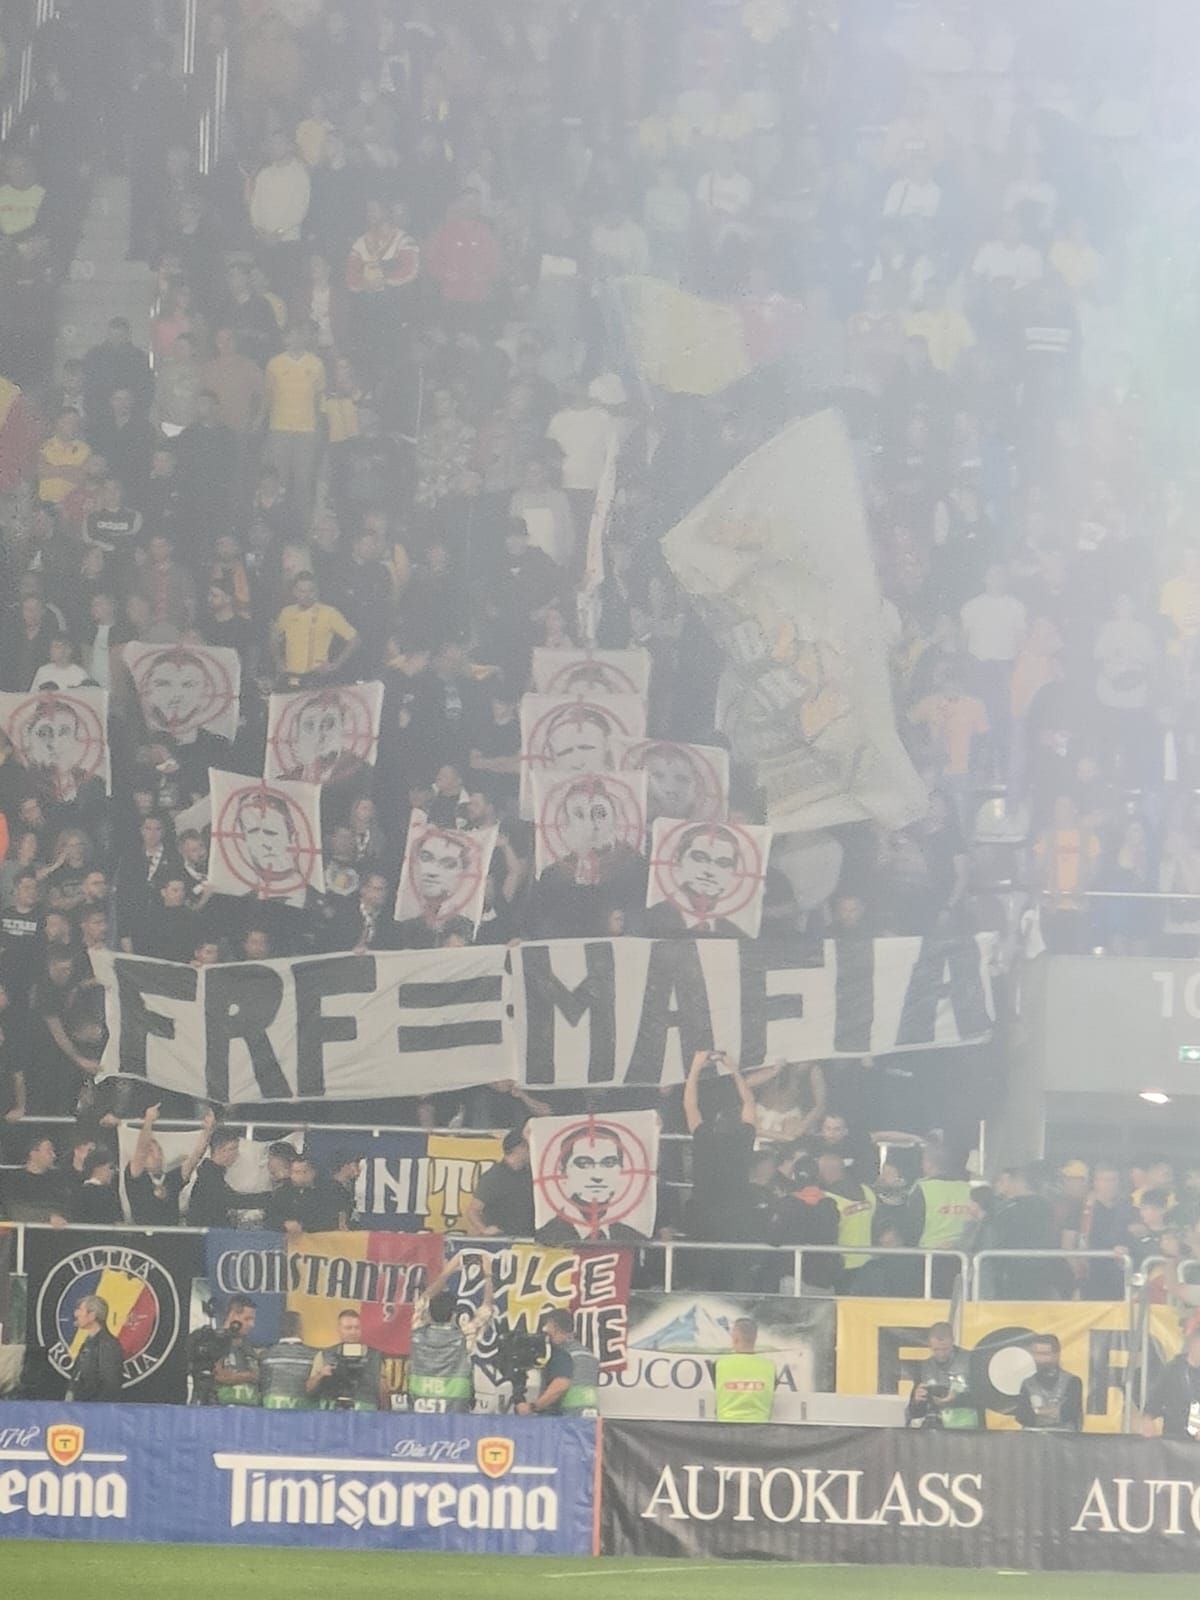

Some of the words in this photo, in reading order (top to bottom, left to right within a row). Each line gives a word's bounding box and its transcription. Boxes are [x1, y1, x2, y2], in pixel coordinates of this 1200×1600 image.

[113, 953, 377, 1100] FRF
[522, 937, 994, 1085] MAFIA
[457, 1248, 620, 1305] DULCE
[231, 1385, 256, 1400] TV
[428, 1438, 471, 1461] 1718
[0, 1469, 127, 1518] eana
[212, 1453, 558, 1530] Timișoreana
[641, 1465, 984, 1529] AUTOKLASS
[1071, 1478, 1200, 1534] AUT
